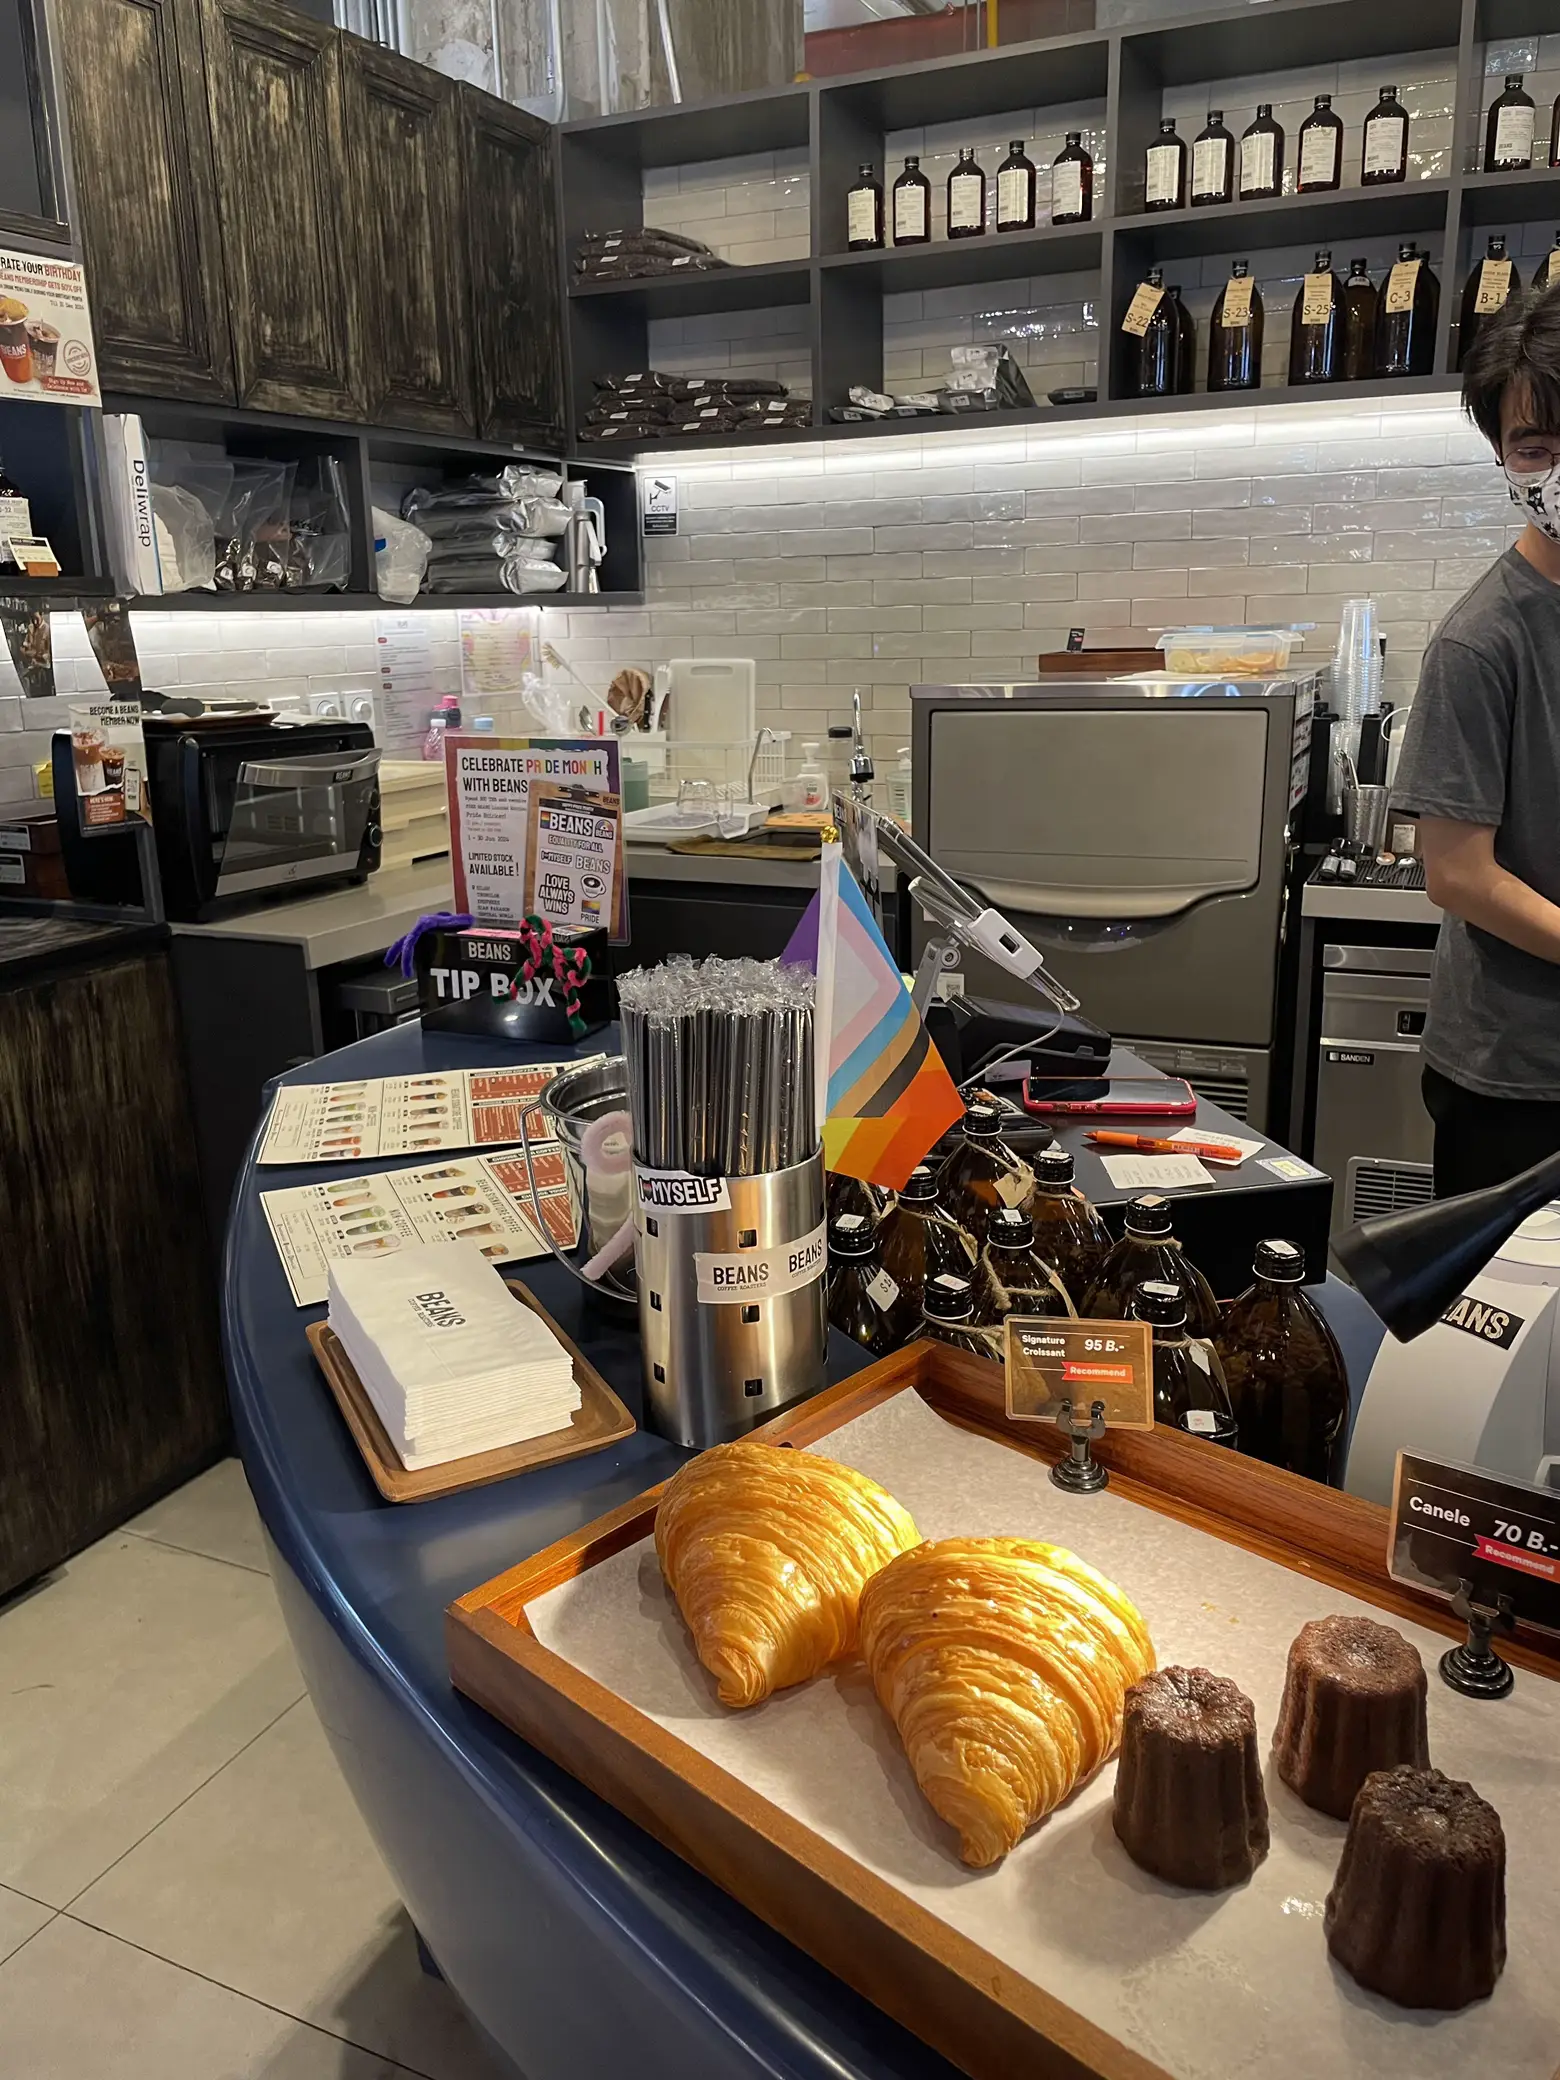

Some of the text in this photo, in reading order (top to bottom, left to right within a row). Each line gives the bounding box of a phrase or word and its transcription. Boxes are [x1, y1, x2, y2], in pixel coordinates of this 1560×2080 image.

[22, 261, 44, 276] YOUR
[44, 264, 81, 282] BIRTHDAY
[1390, 290, 1411, 304] C-3
[1480, 292, 1502, 305] B-1
[1223, 307, 1249, 319] S-23
[1304, 304, 1329, 316] S-25
[1126, 313, 1149, 328] S-22
[133, 460, 151, 548] Deliwrap
[651, 505, 670, 513] CCTV
[89, 706, 114, 716] BECOME
[119, 704, 139, 714] BEANS
[100, 715, 141, 726] MEMBER NOW
[461, 756, 524, 773] CELEBRATE
[463, 777, 528, 794] WITH BEANS
[549, 813, 593, 836] BEANS
[595, 829, 613, 839] BEANS
[548, 834, 604, 853] EQUALITY FOR ALL
[468, 851, 513, 863] LIMITED STOCK
[548, 852, 573, 864] MYSELF
[576, 855, 611, 874] BEANS
[546, 874, 569, 889] LOVE
[539, 886, 574, 903] ALWAYS
[545, 898, 568, 914] WINS
[580, 913, 600, 924] PRIDE
[468, 941, 511, 961] BEANS
[430, 968, 556, 1008] TIP BOX
[1340, 1053, 1371, 1063] SANDEN
[652, 1177, 721, 1206] MYSELF
[788, 1238, 823, 1274] BEANS
[713, 1262, 770, 1286] BEANS
[739, 1281, 767, 1291] ROASTERS
[415, 1291, 466, 1327] BEANS
[1442, 1298, 1510, 1340] ANS
[1021, 1334, 1125, 1353] Signature 95 B.-
[1022, 1347, 1066, 1358] Croissant
[1069, 1366, 1126, 1377] Recommend
[1408, 1495, 1559, 1553] Canele 70 B.-
[1484, 1544, 1555, 1576] Recommend
